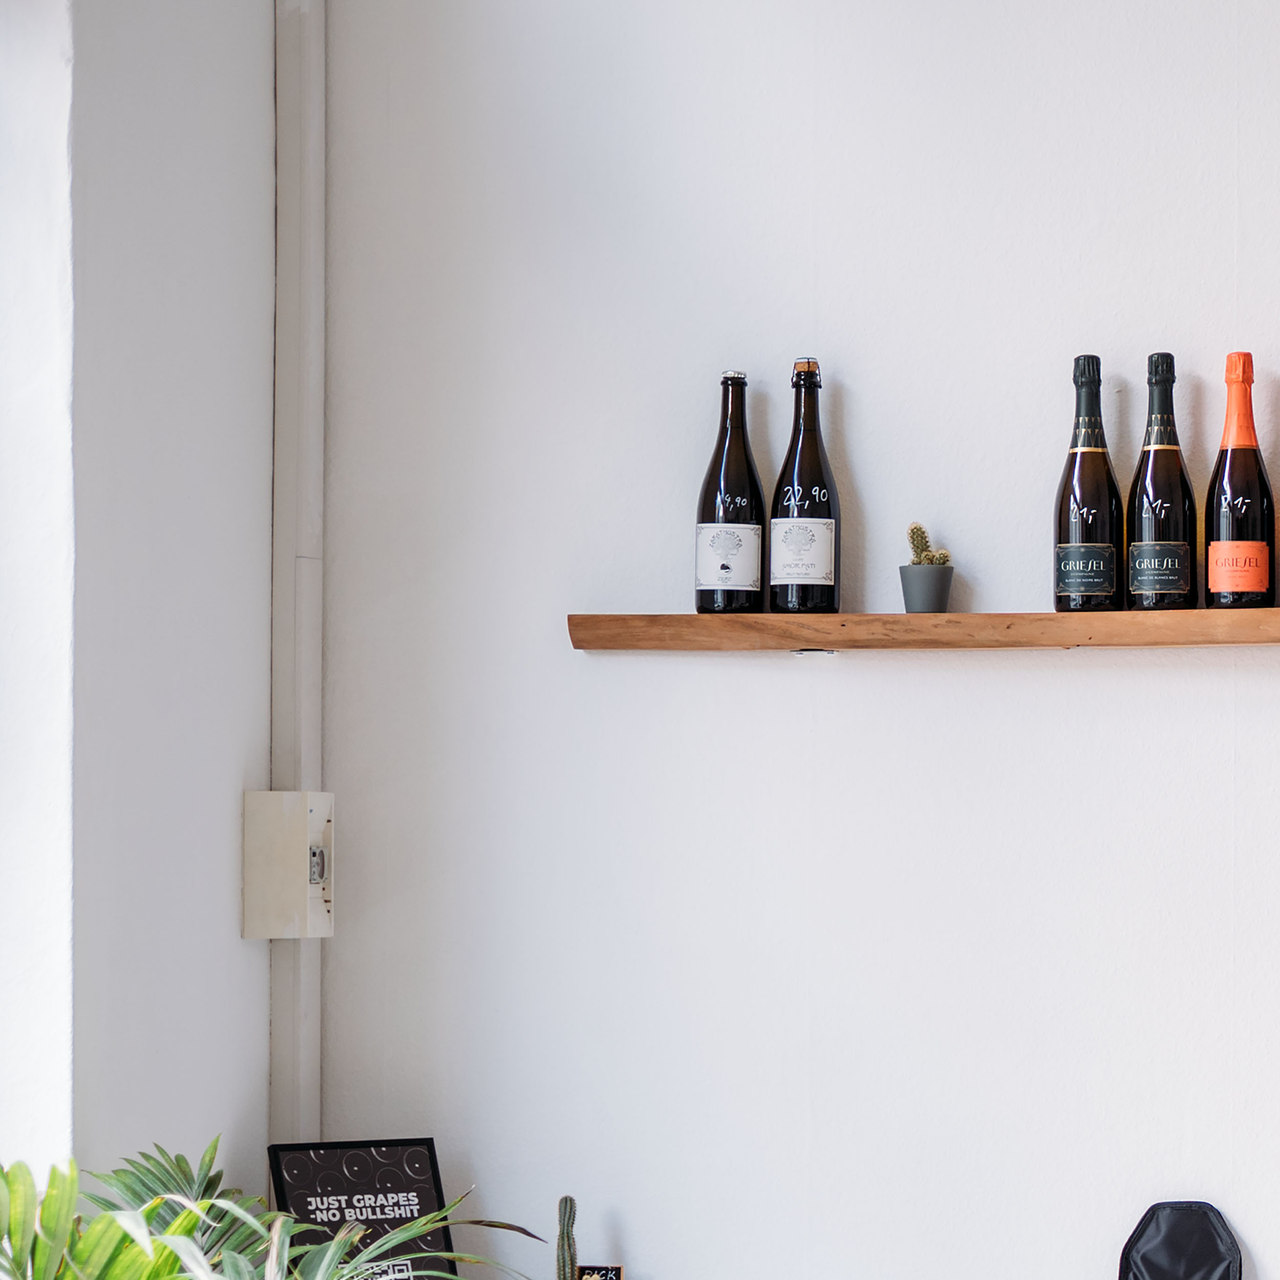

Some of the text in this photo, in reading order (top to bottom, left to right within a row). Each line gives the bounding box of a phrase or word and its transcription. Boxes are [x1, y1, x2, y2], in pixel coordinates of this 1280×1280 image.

[783, 486, 829, 509] 22,90
[307, 1192, 419, 1210] JUST GRAPES
[310, 1205, 420, 1222] -NO BULLSHIT
